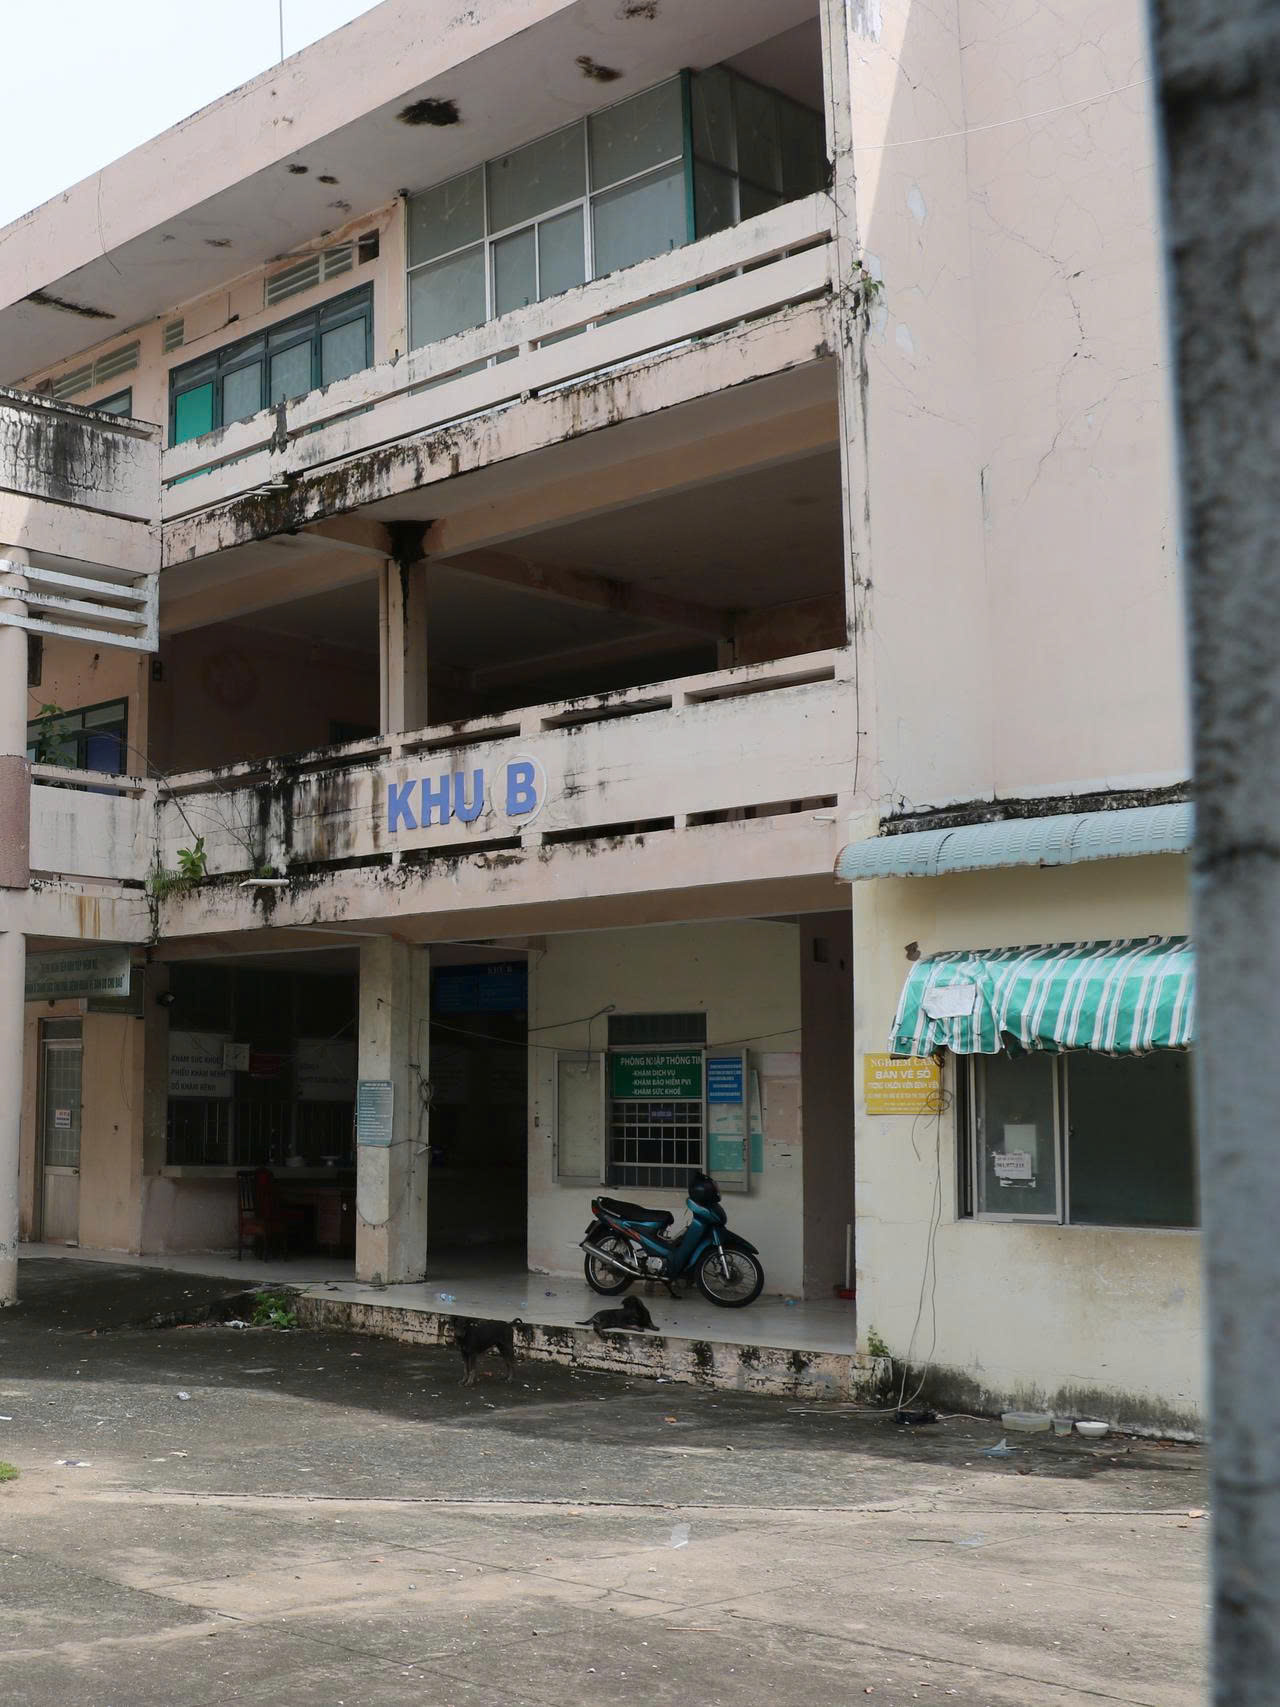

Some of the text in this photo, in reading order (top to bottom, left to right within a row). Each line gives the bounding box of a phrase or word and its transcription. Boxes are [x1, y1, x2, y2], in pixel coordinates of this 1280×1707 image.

[388, 762, 537, 832] KHU B
[666, 1055, 691, 1065] THÔNG
